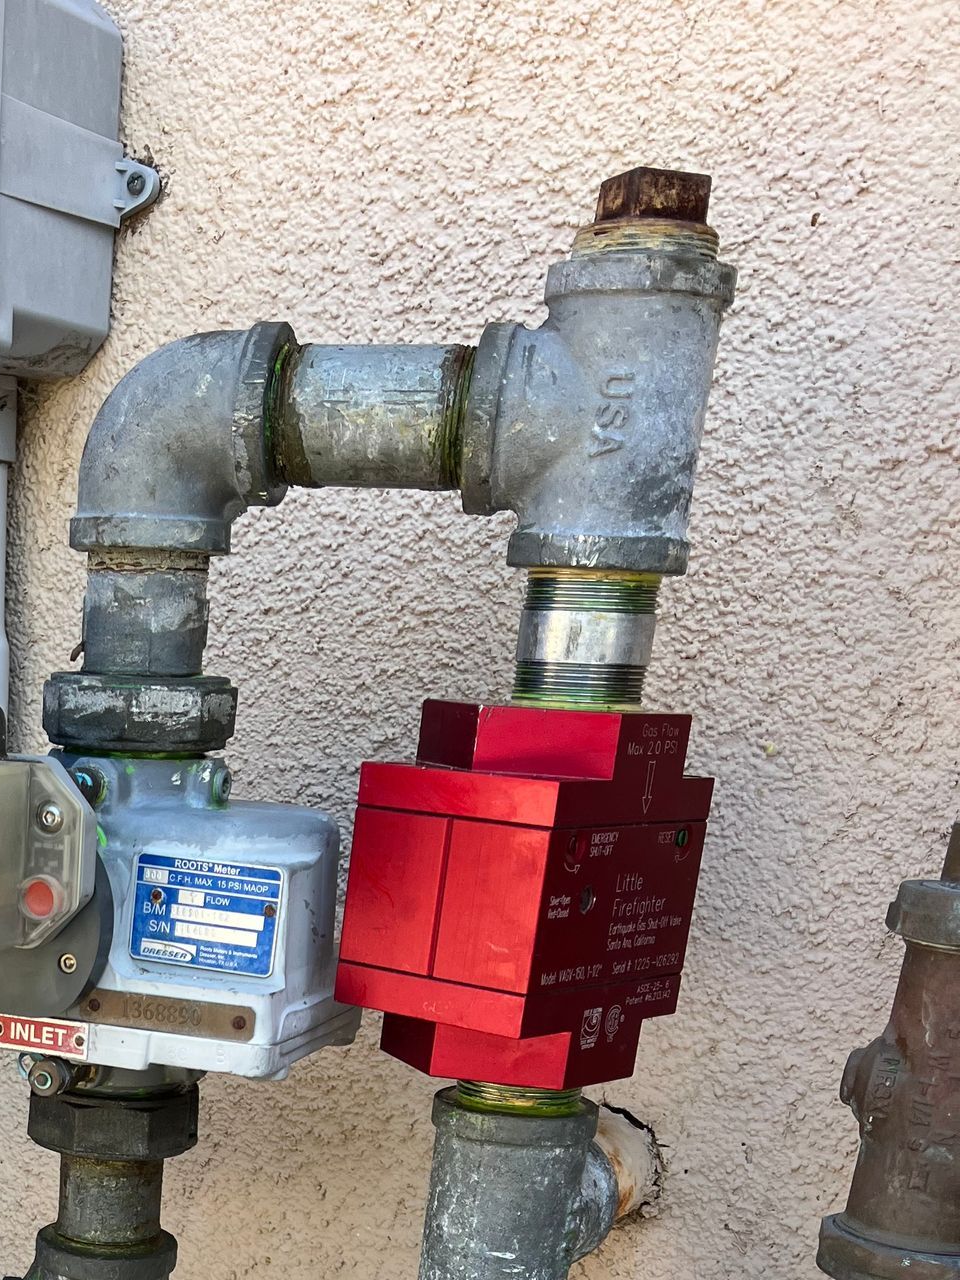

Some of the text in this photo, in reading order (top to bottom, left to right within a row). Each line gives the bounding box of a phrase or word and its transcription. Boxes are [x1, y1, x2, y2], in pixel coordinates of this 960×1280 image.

[588, 372, 635, 458] USA
[642, 722, 680, 738] Gas Flow
[627, 741, 644, 756] Max
[213, 863, 241, 876] Meter
[194, 876, 213, 887] MAX
[227, 881, 242, 891] PSI
[243, 883, 269, 893] MAOP
[616, 873, 644, 893] Little
[142, 901, 166, 916] B/M
[205, 895, 231, 906] FLOW
[611, 896, 667, 921] Firefighter
[148, 920, 171, 933] S/N
[141, 946, 188, 960] DRESSER
[120, 998, 204, 1028] 1368890
[9, 1021, 68, 1048] INLET
